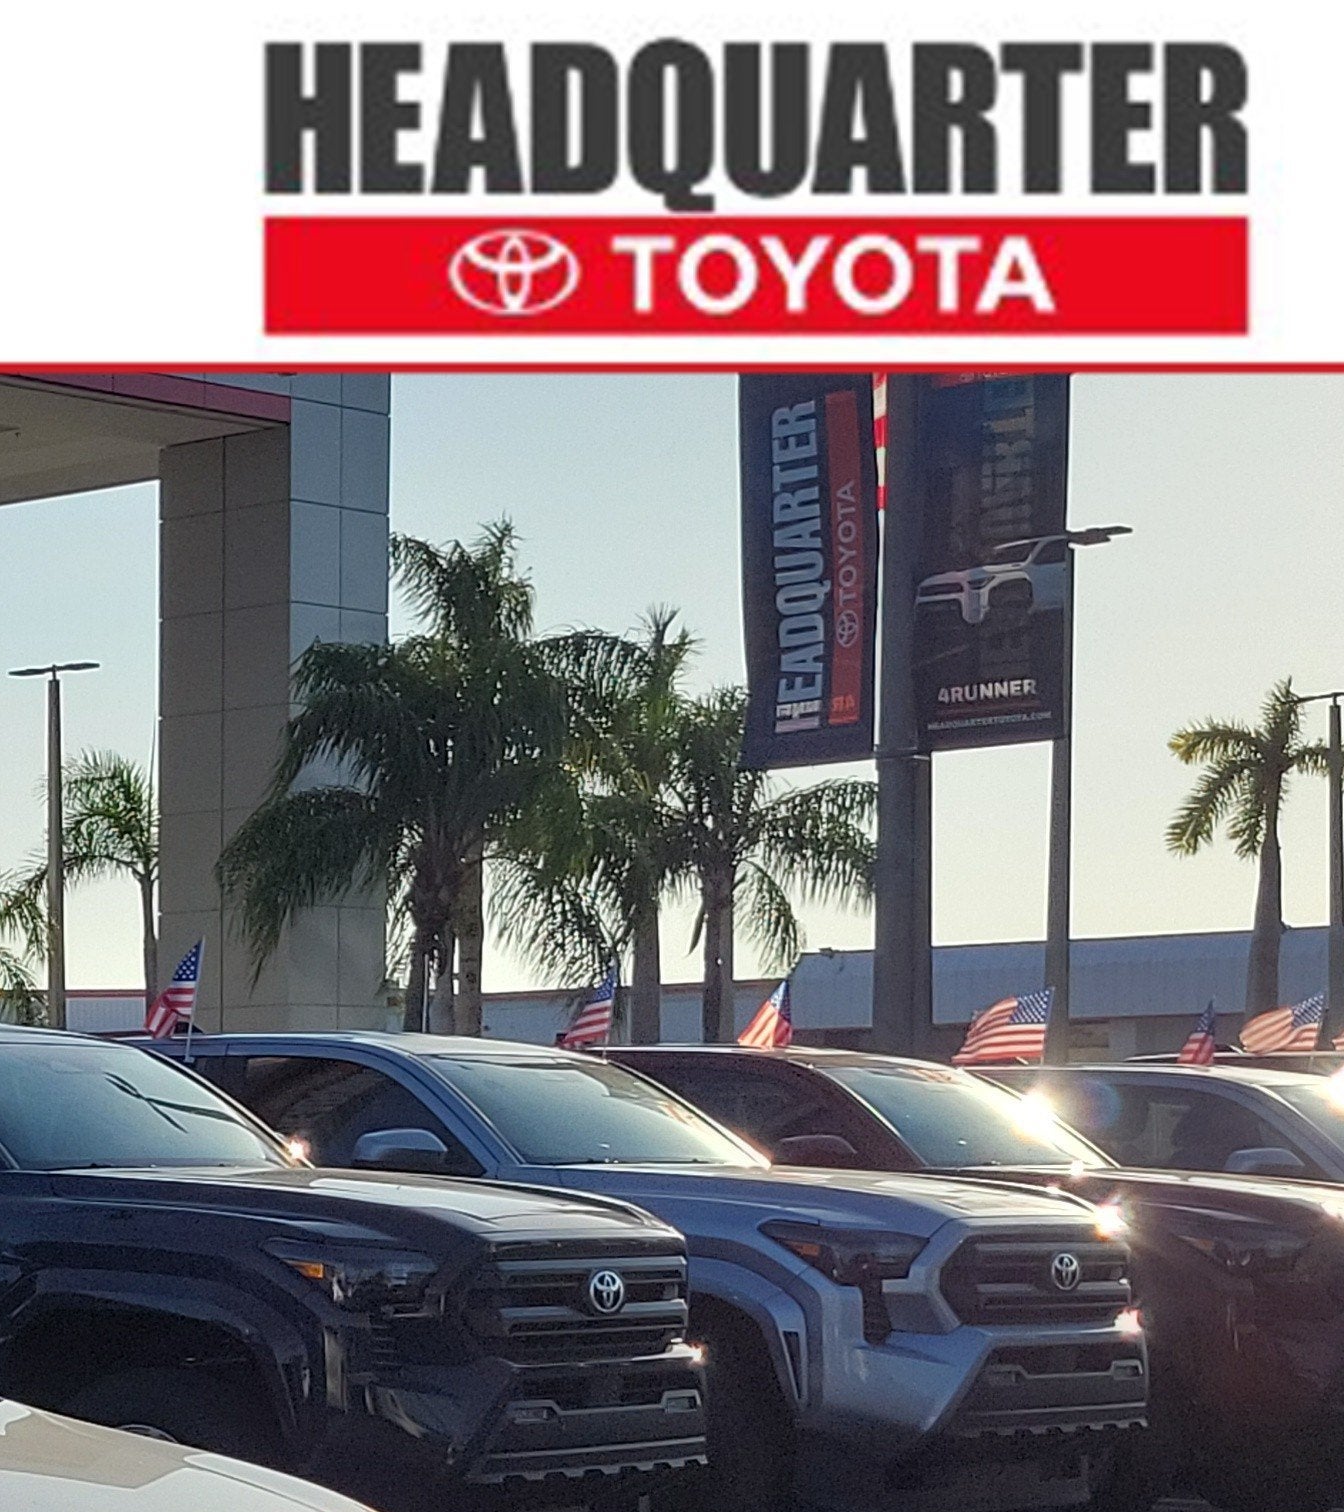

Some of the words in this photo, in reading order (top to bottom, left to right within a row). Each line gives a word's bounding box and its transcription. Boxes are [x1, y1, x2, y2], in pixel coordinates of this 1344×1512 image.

[771, 400, 831, 734] HEADQUARTER
[835, 481, 859, 604] TOYOTA
[937, 678, 1037, 704] 4RUNNER
